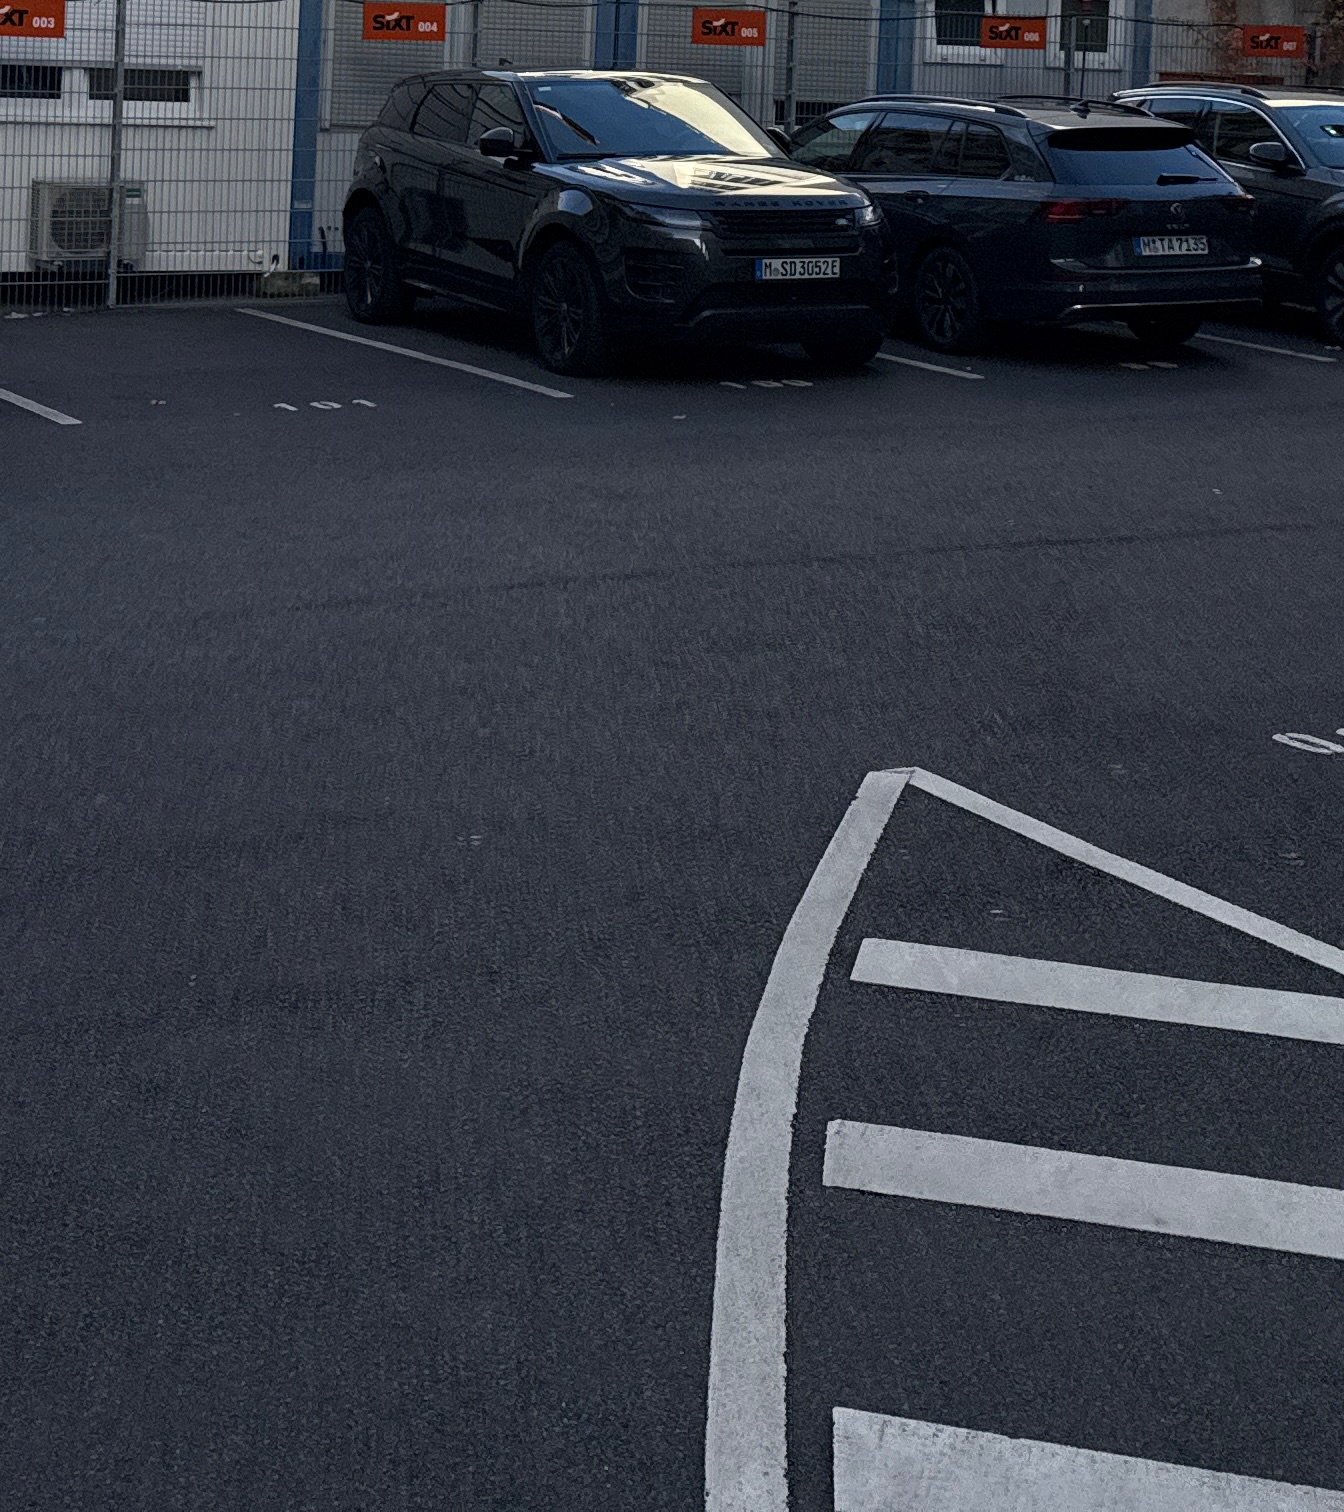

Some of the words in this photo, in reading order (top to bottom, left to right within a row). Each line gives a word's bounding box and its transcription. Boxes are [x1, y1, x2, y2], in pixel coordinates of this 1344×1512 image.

[32, 16, 55, 29] 003
[417, 21, 438, 33] 004
[740, 27, 759, 38] 005
[764, 261, 772, 278] M
[780, 260, 797, 277] SD
[798, 259, 838, 276] 3052E
[273, 398, 378, 412] 101
